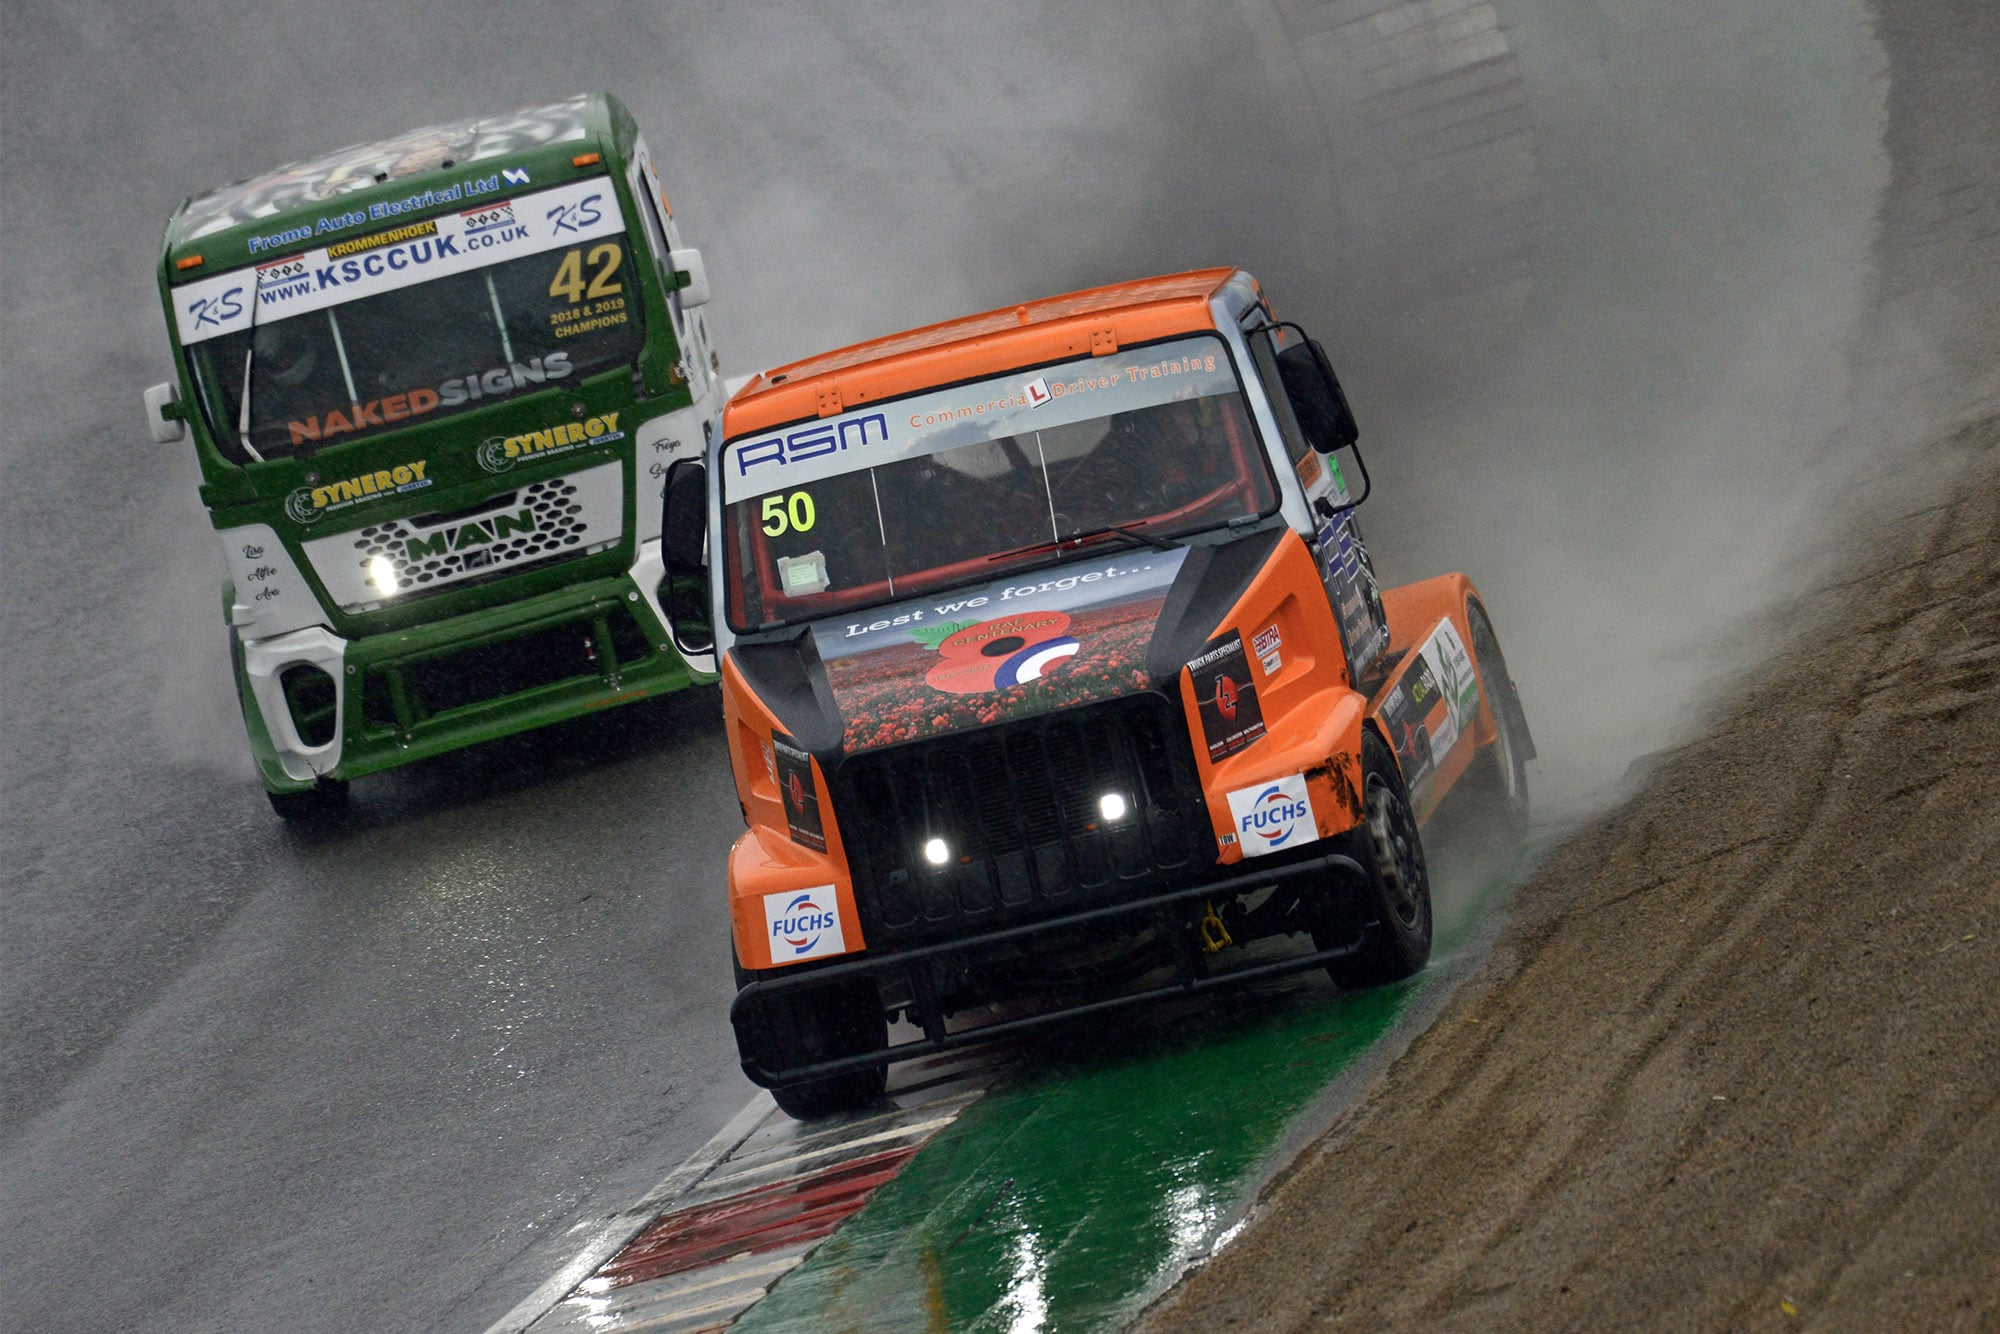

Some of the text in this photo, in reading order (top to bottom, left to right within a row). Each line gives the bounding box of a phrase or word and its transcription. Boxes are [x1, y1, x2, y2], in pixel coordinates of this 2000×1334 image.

[248, 225, 312, 254] Frome
[315, 211, 367, 236] Auto
[369, 185, 462, 221] Electrical
[465, 175, 500, 198] Ltd
[328, 222, 437, 258] KROMMENHOEK
[549, 243, 623, 304] 42
[550, 297, 626, 325] 2018 & 2019
[555, 312, 628, 339] CHAMPIONS
[1052, 374, 1119, 398] Driver
[1125, 355, 1217, 383] Training
[503, 412, 620, 459] SYNERGY
[736, 413, 889, 477] RSM
[311, 460, 427, 509] SYNERGY
[761, 491, 816, 538] 50
[405, 508, 537, 563] MAN
[844, 565, 1152, 638] Lest we forget...
[952, 617, 1060, 647] CENTENARY
[989, 617, 1025, 632] RAF
[1186, 655, 1206, 672] TRUCK
[1205, 648, 1220, 666] PARTS
[1218, 638, 1241, 659] SPECIALIST
[1241, 800, 1307, 833] FUCHS
[1220, 833, 1234, 846] TOW
[772, 911, 834, 937] FUCHS
